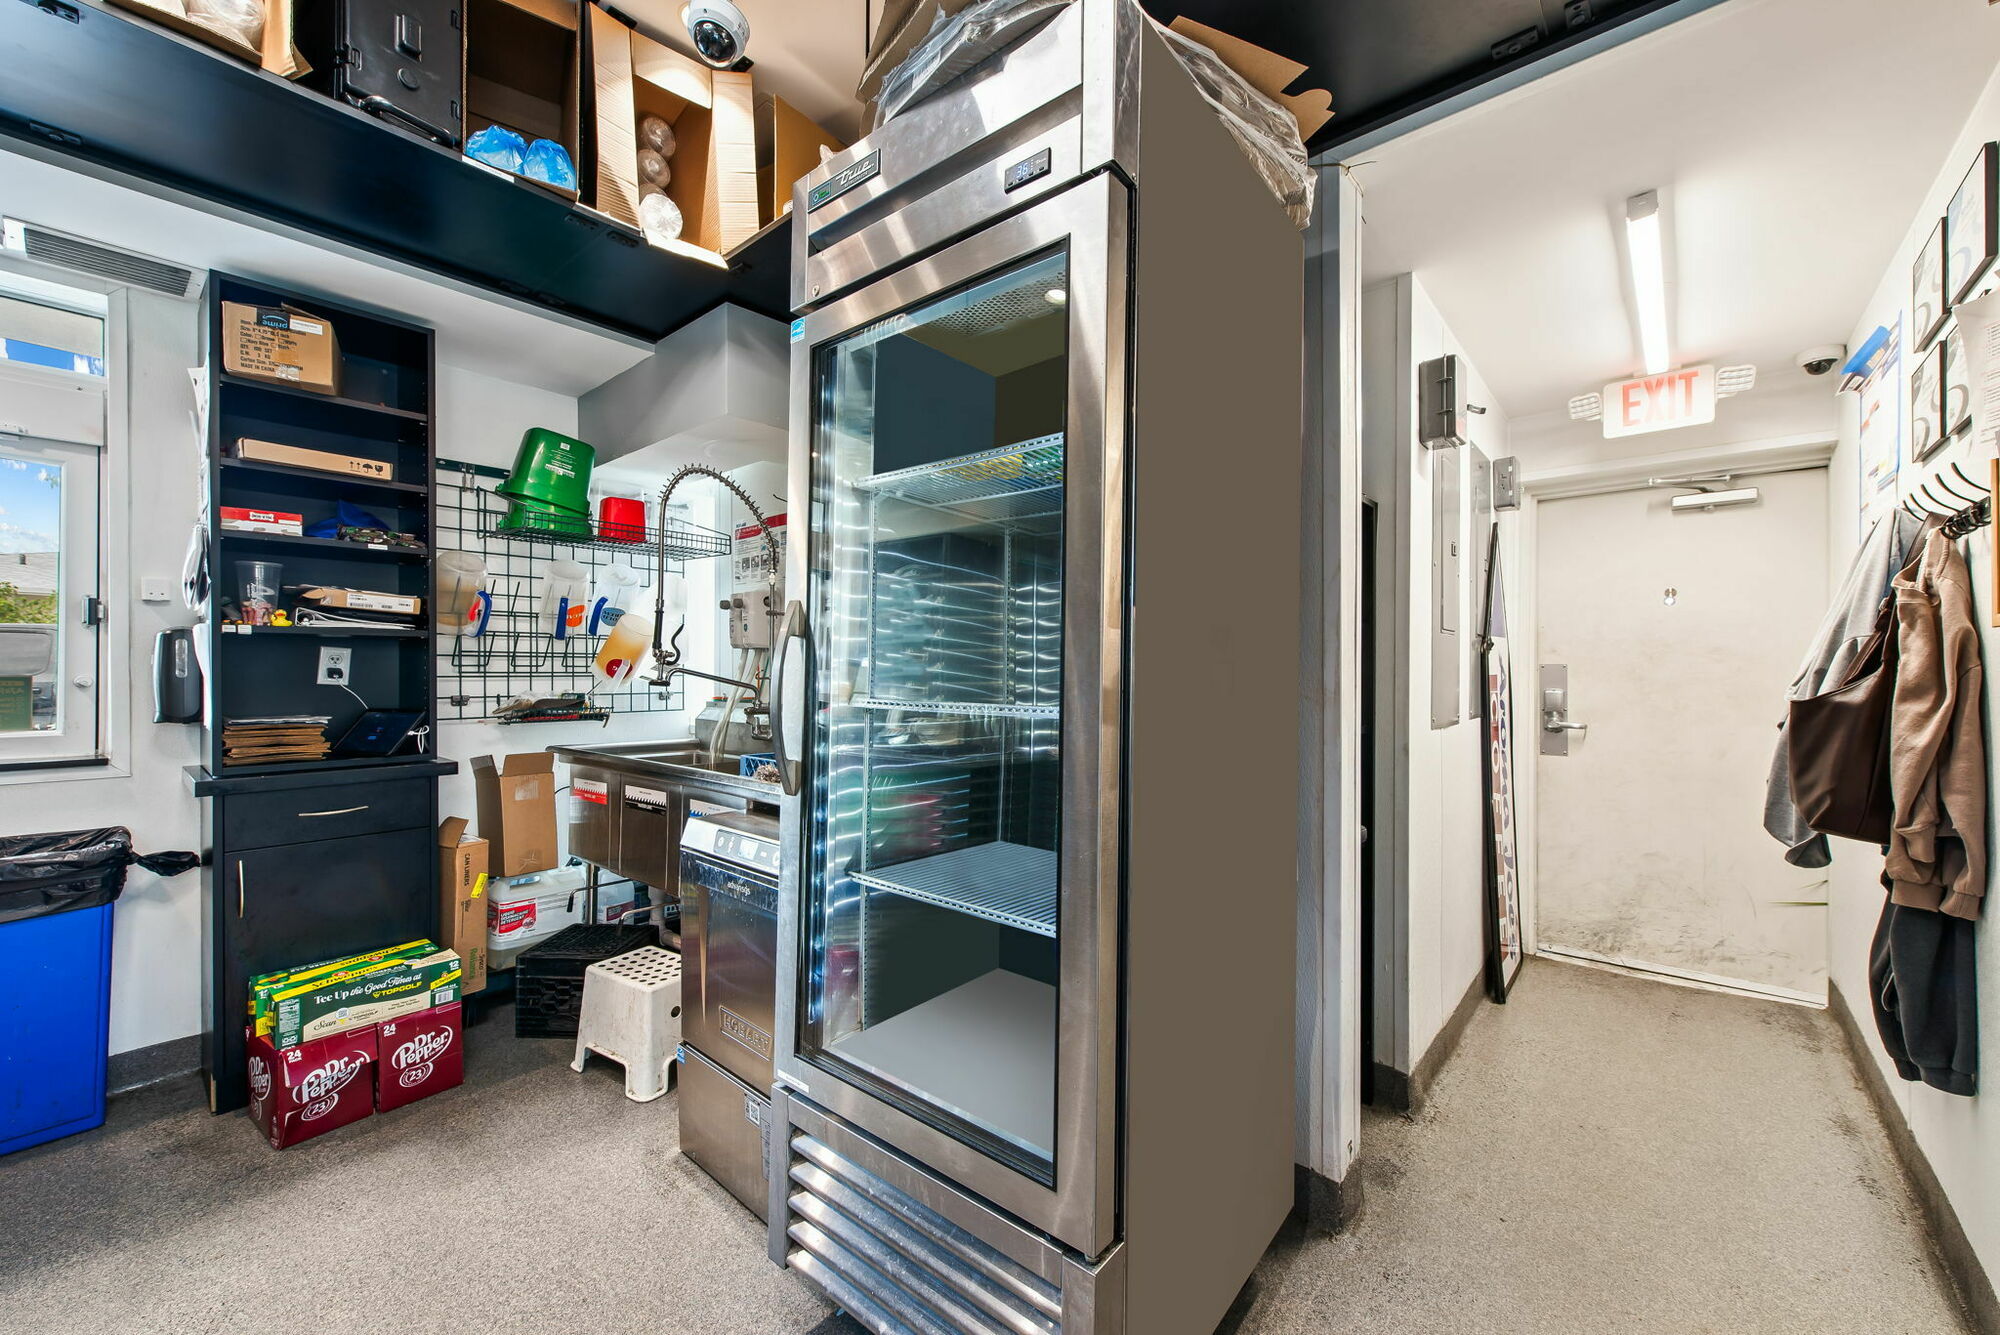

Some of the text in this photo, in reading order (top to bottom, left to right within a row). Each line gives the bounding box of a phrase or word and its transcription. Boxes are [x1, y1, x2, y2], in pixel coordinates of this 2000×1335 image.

[1016, 162, 1028, 179] 36
[262, 320, 288, 329] prime
[1622, 370, 1699, 426] EXIT
[1490, 691, 1509, 942] COFFEE
[501, 914, 525, 925] DETERGENT
[449, 960, 460, 968] 12
[312, 966, 378, 988] Schweppes
[314, 973, 423, 1005] Tee Up the Good Times at
[381, 981, 423, 996] TOPGOLF
[313, 1020, 337, 1031] Scan
[383, 1023, 396, 1033] 24
[724, 1013, 769, 1053] HOBART
[399, 1031, 449, 1069] Pepper
[414, 1031, 436, 1050] Dr
[287, 1050, 302, 1060] 24
[249, 1056, 268, 1093] Pepper
[255, 1056, 264, 1075] Dr
[324, 1057, 349, 1076] Dr
[409, 1069, 422, 1081] 23
[302, 1057, 365, 1104] Pepper
[312, 1101, 326, 1114] 23
